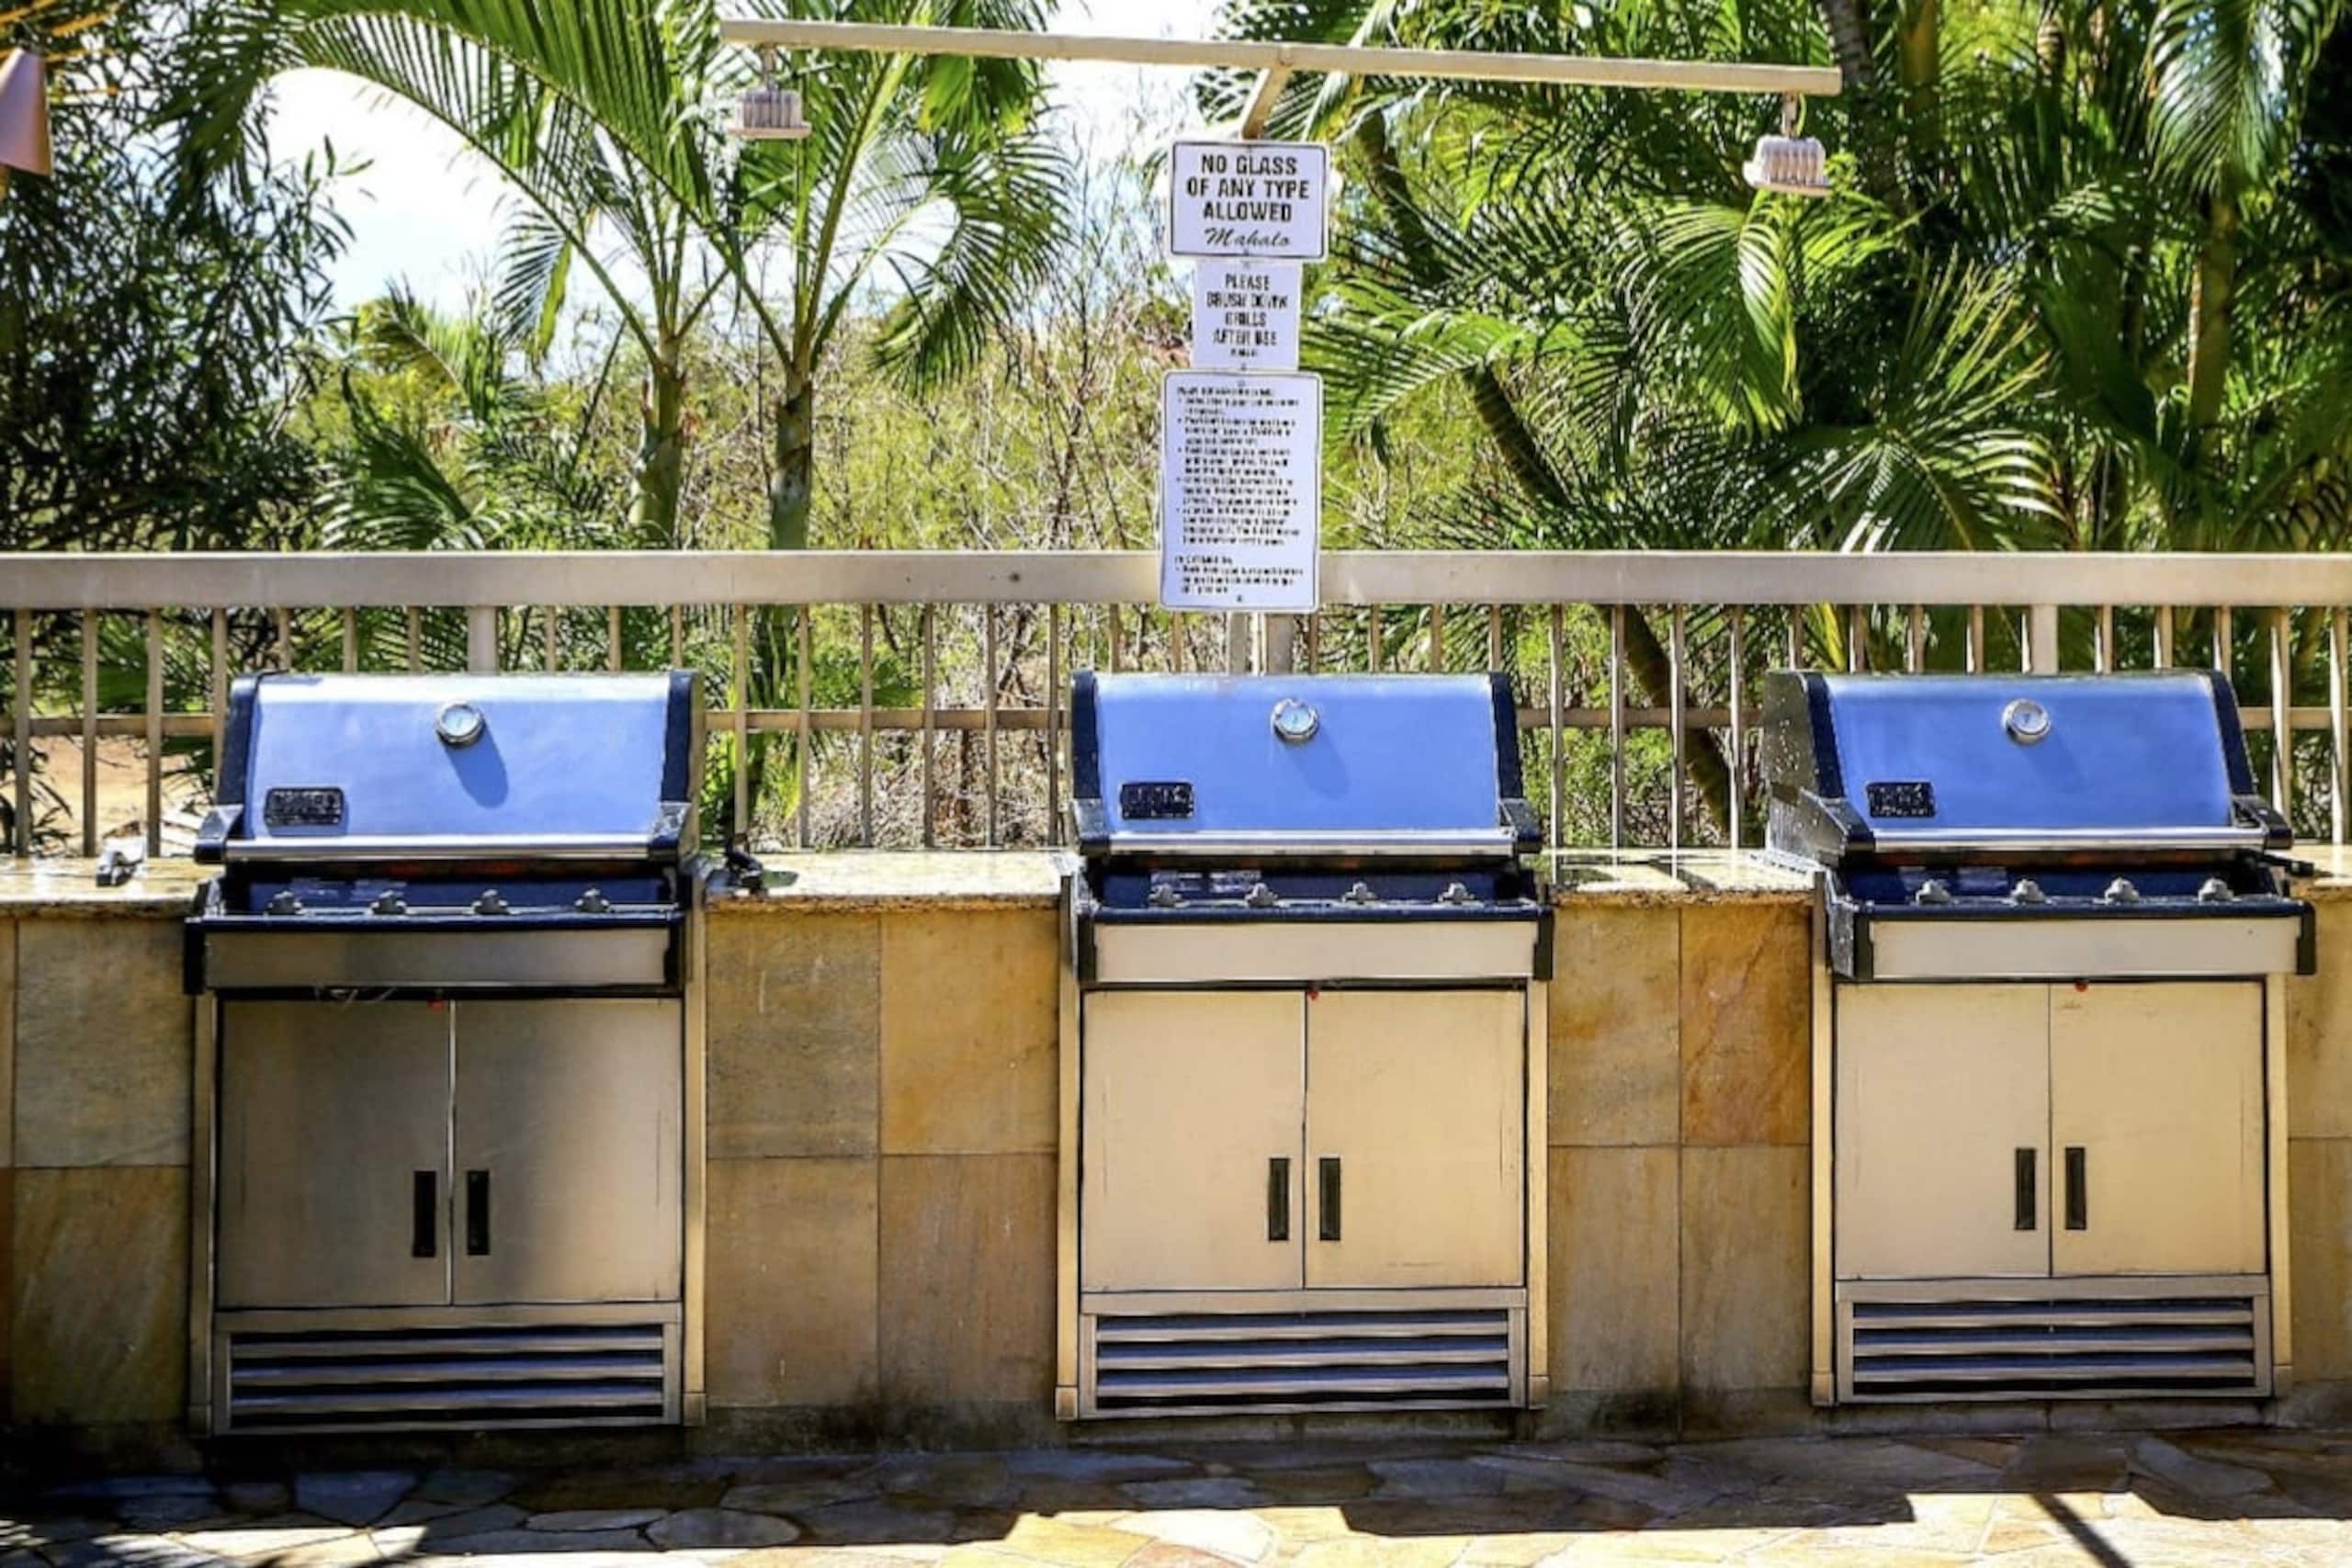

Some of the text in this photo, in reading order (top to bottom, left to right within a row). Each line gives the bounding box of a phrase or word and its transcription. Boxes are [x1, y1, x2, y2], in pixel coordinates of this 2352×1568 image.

[1202, 154, 1297, 175] NO GLASS
[1187, 177, 1309, 199] OF ANY TYPE
[1203, 201, 1292, 222] ALLOWED
[1204, 227, 1290, 247] Mahalo
[1225, 273, 1270, 291] PLEASE
